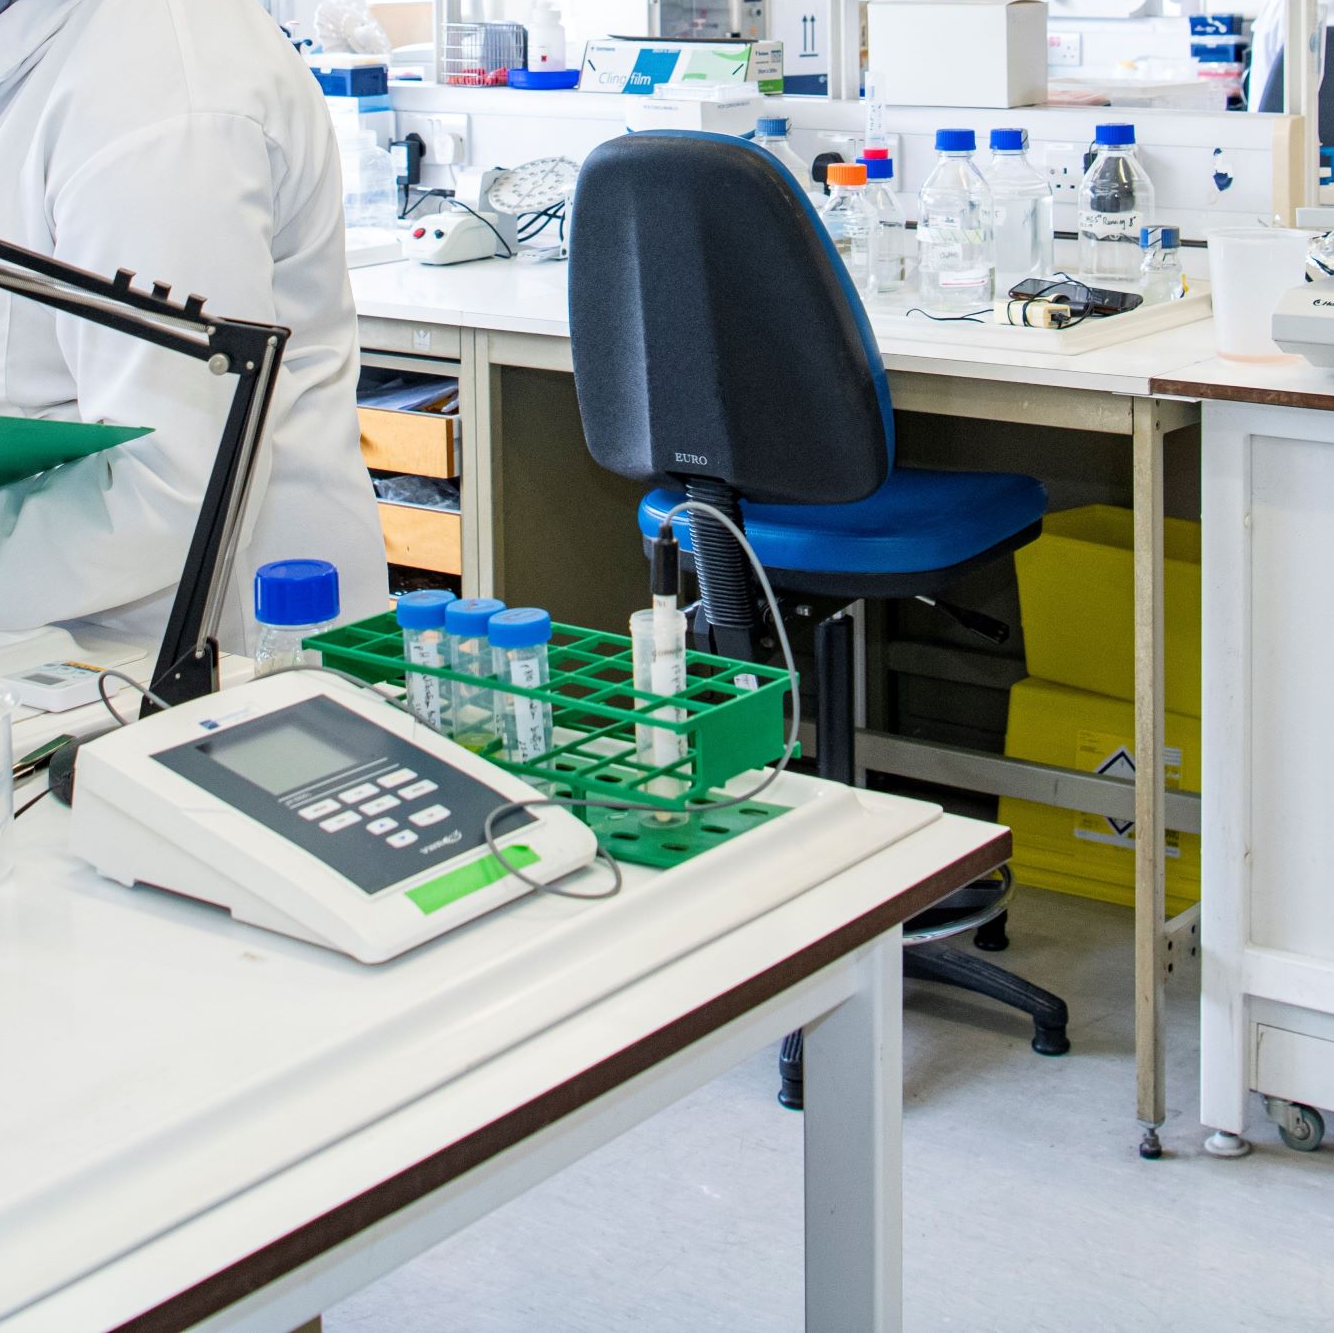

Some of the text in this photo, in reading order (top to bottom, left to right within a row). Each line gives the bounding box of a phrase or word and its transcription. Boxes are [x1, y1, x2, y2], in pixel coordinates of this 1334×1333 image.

[599, 72, 651, 87] Cling film
[674, 452, 708, 466] EURO
